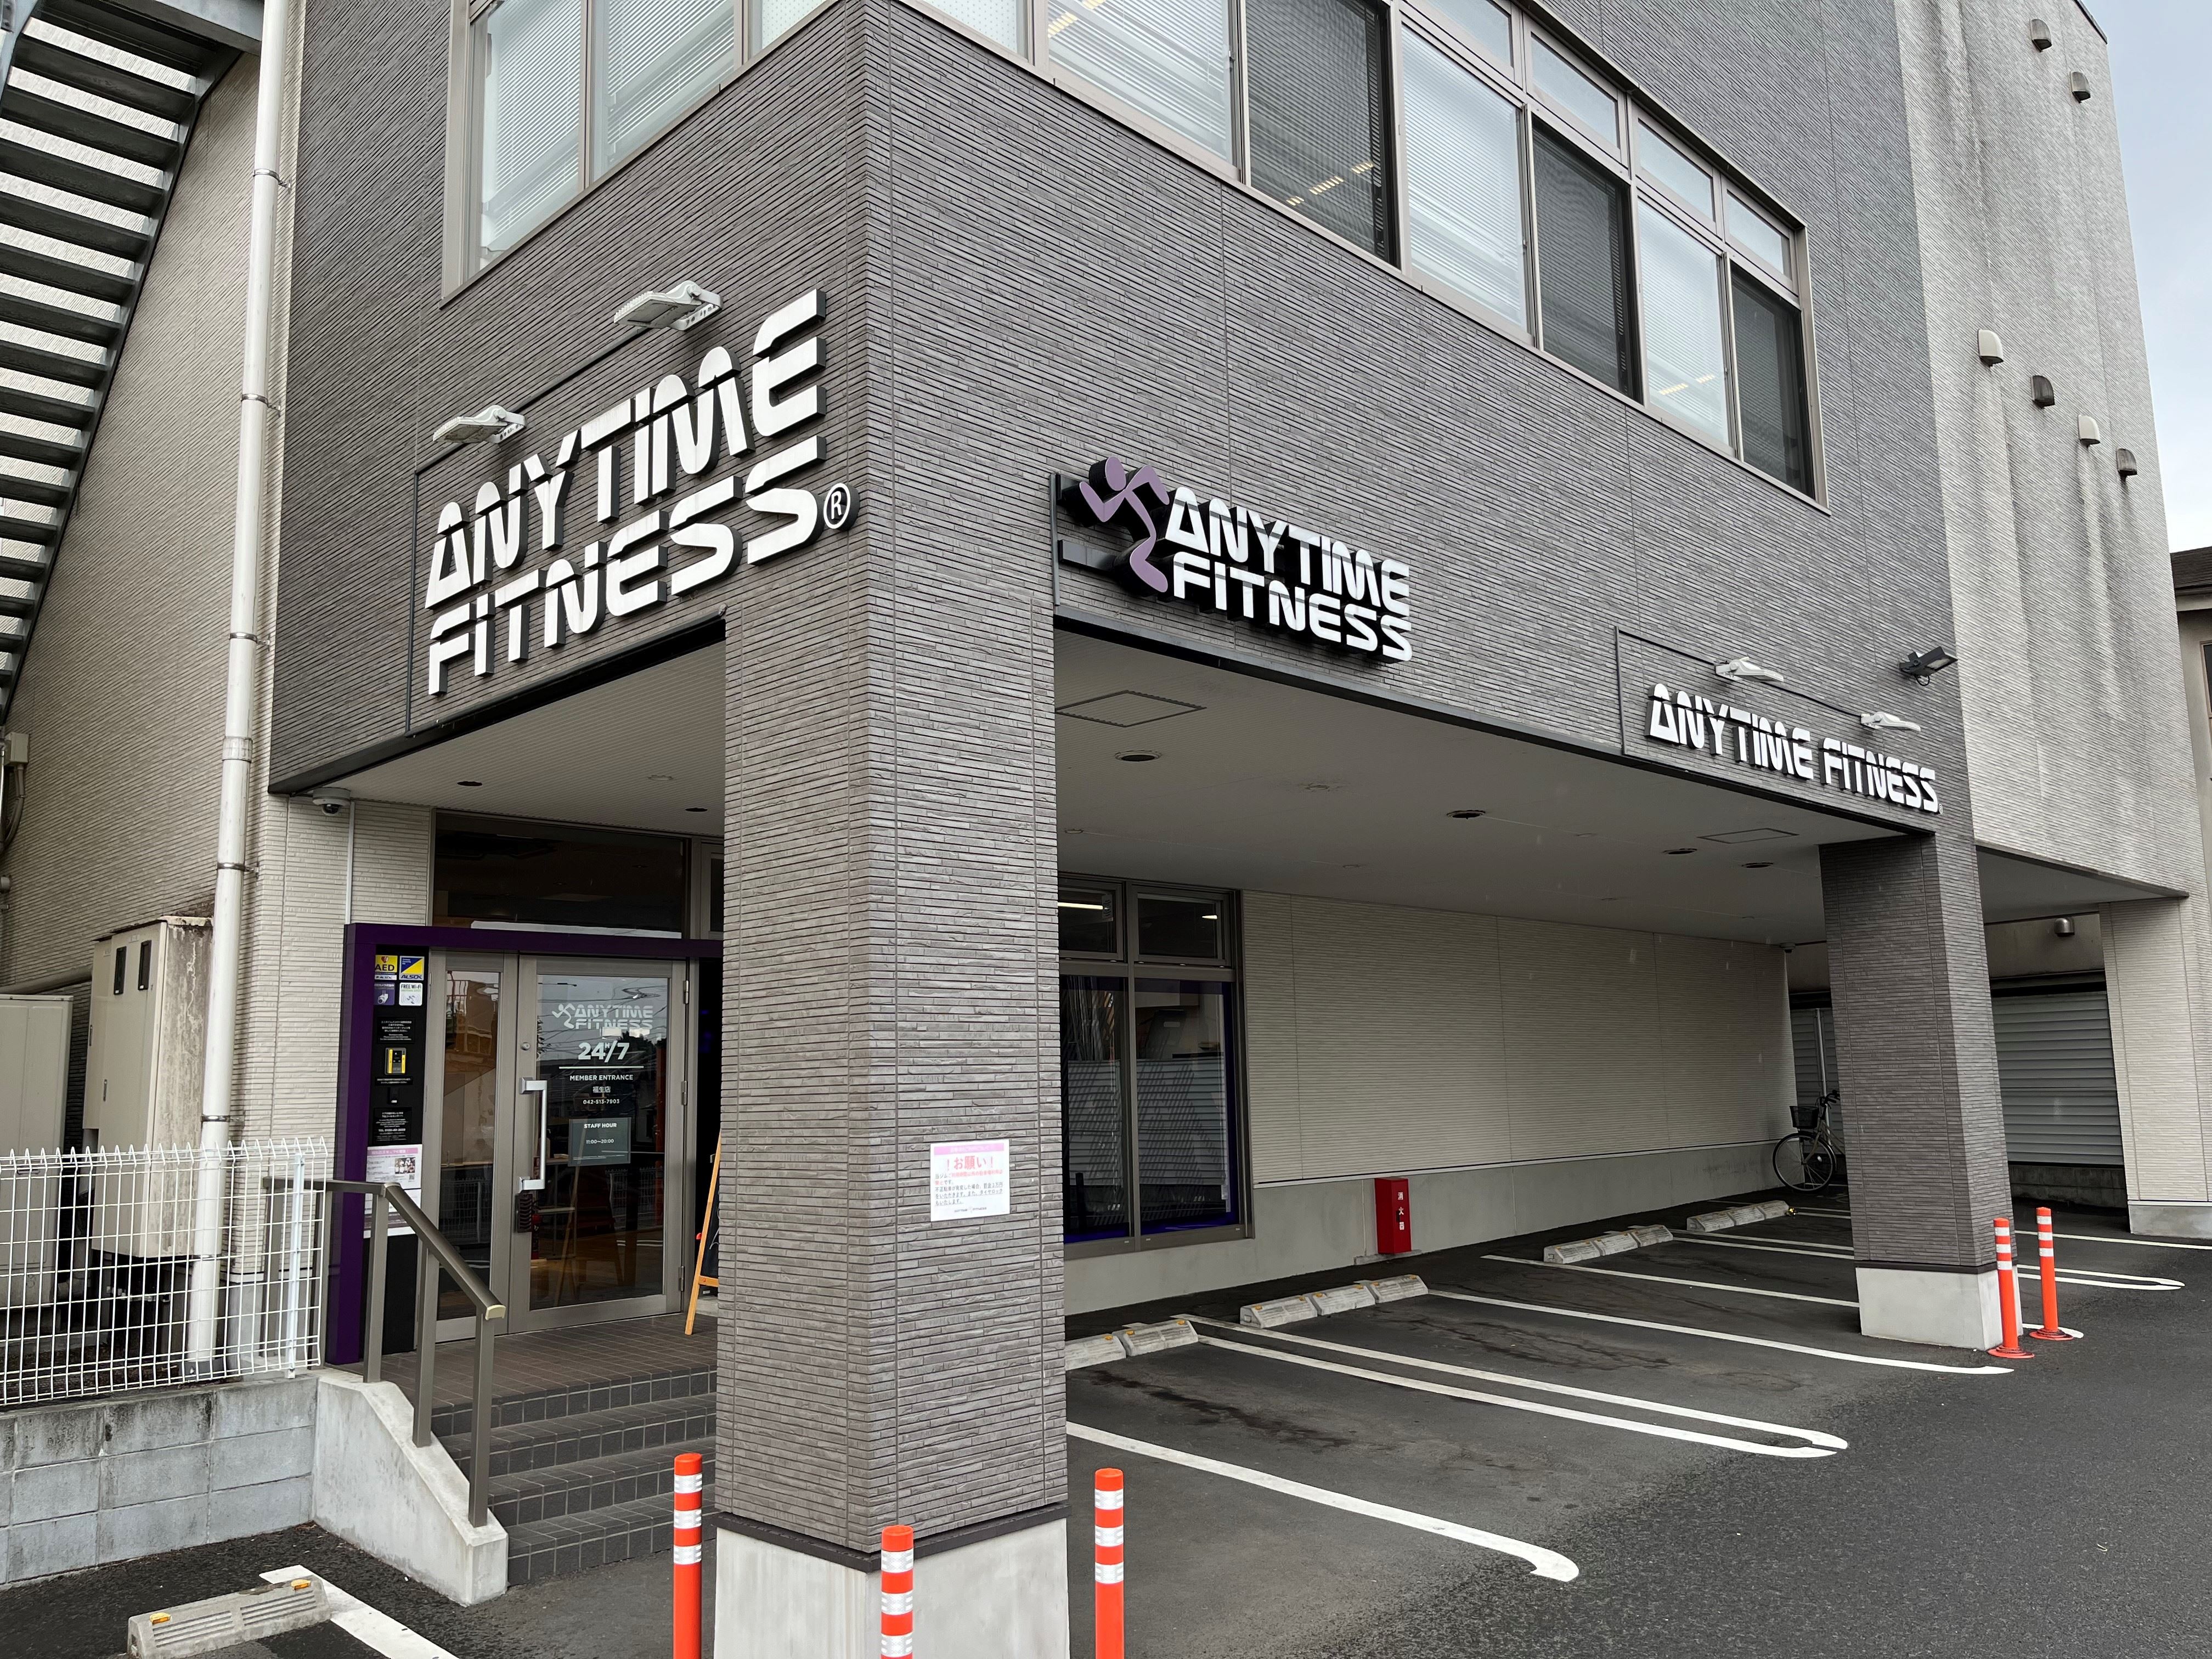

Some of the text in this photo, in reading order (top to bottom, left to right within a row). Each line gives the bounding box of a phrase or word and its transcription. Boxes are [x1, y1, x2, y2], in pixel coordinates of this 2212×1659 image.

[424, 288, 826, 610] ANYTIME
[1165, 487, 1409, 617] ANYTIME
[1173, 551, 1412, 662] FITNESS
[1646, 683, 1814, 780] ANYTIME
[574, 1004, 653, 1018] ANYTIME
[575, 1019, 653, 1030] FITNESS
